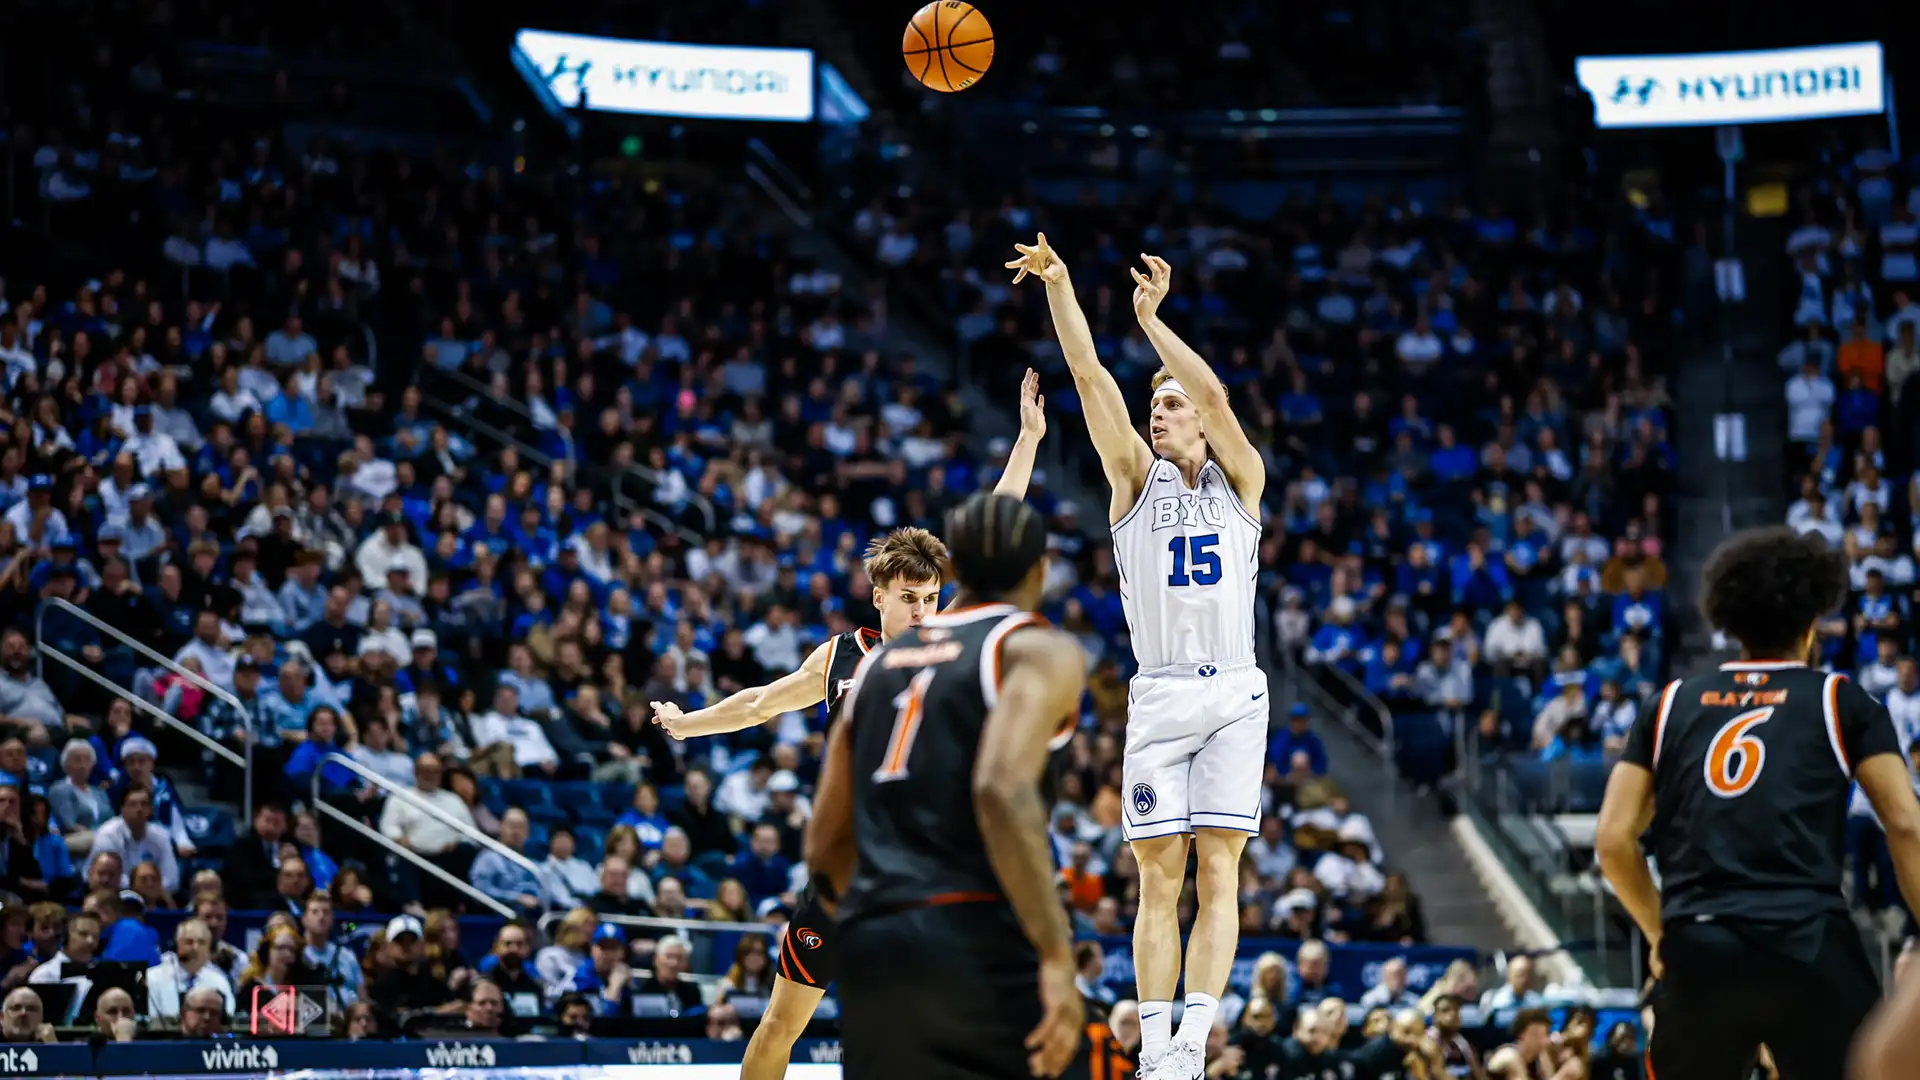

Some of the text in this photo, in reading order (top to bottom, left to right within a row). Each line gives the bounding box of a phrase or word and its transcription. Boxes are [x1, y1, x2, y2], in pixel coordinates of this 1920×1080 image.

[612, 63, 788, 95] HYUNDAI
[1678, 64, 1861, 102] HYUNDAI
[1152, 494, 1226, 532] BYU
[1168, 533, 1223, 587] 15
[870, 666, 937, 783] 1
[1704, 706, 1775, 798] 6
[202, 1042, 261, 1070] vivint
